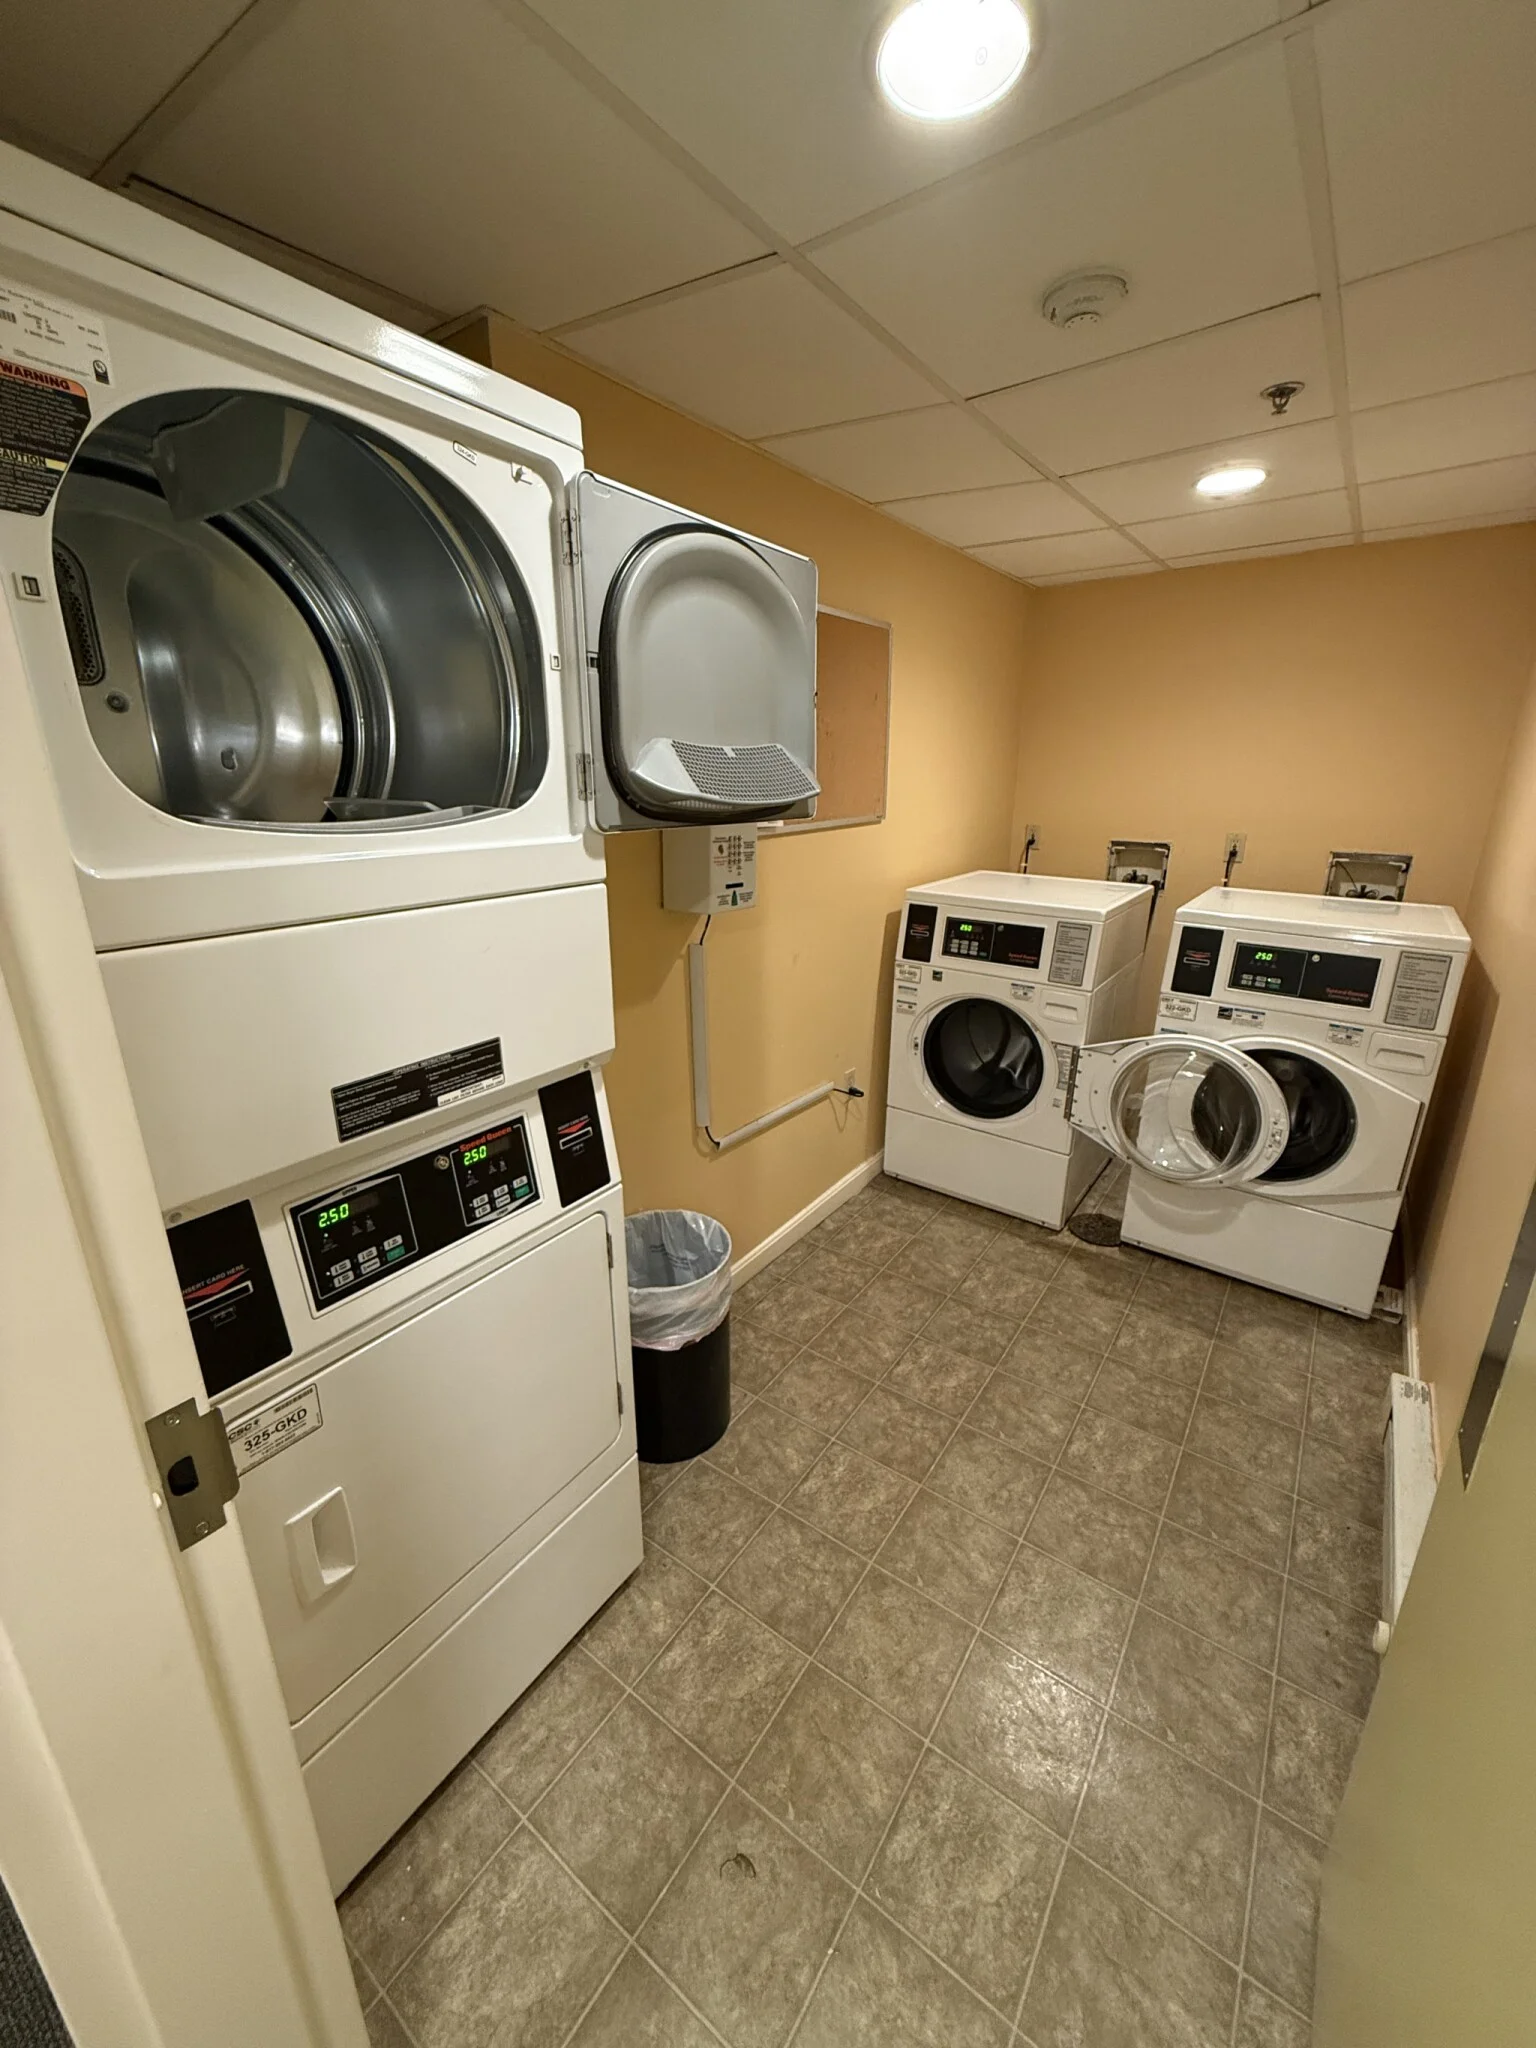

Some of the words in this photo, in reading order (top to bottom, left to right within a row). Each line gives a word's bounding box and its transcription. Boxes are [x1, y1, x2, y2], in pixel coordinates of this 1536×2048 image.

[0, 361, 71, 391] WARNING
[0, 448, 47, 467] AUTION
[460, 1135, 486, 1152] Speed
[486, 1126, 513, 1141] Queen
[464, 1145, 487, 1166] 2.50
[318, 1203, 349, 1228] 2.50
[182, 1280, 206, 1295] NSERT
[206, 1271, 226, 1285] CARD
[226, 1263, 246, 1277] HERE
[243, 1407, 308, 1453] 325-GKD
